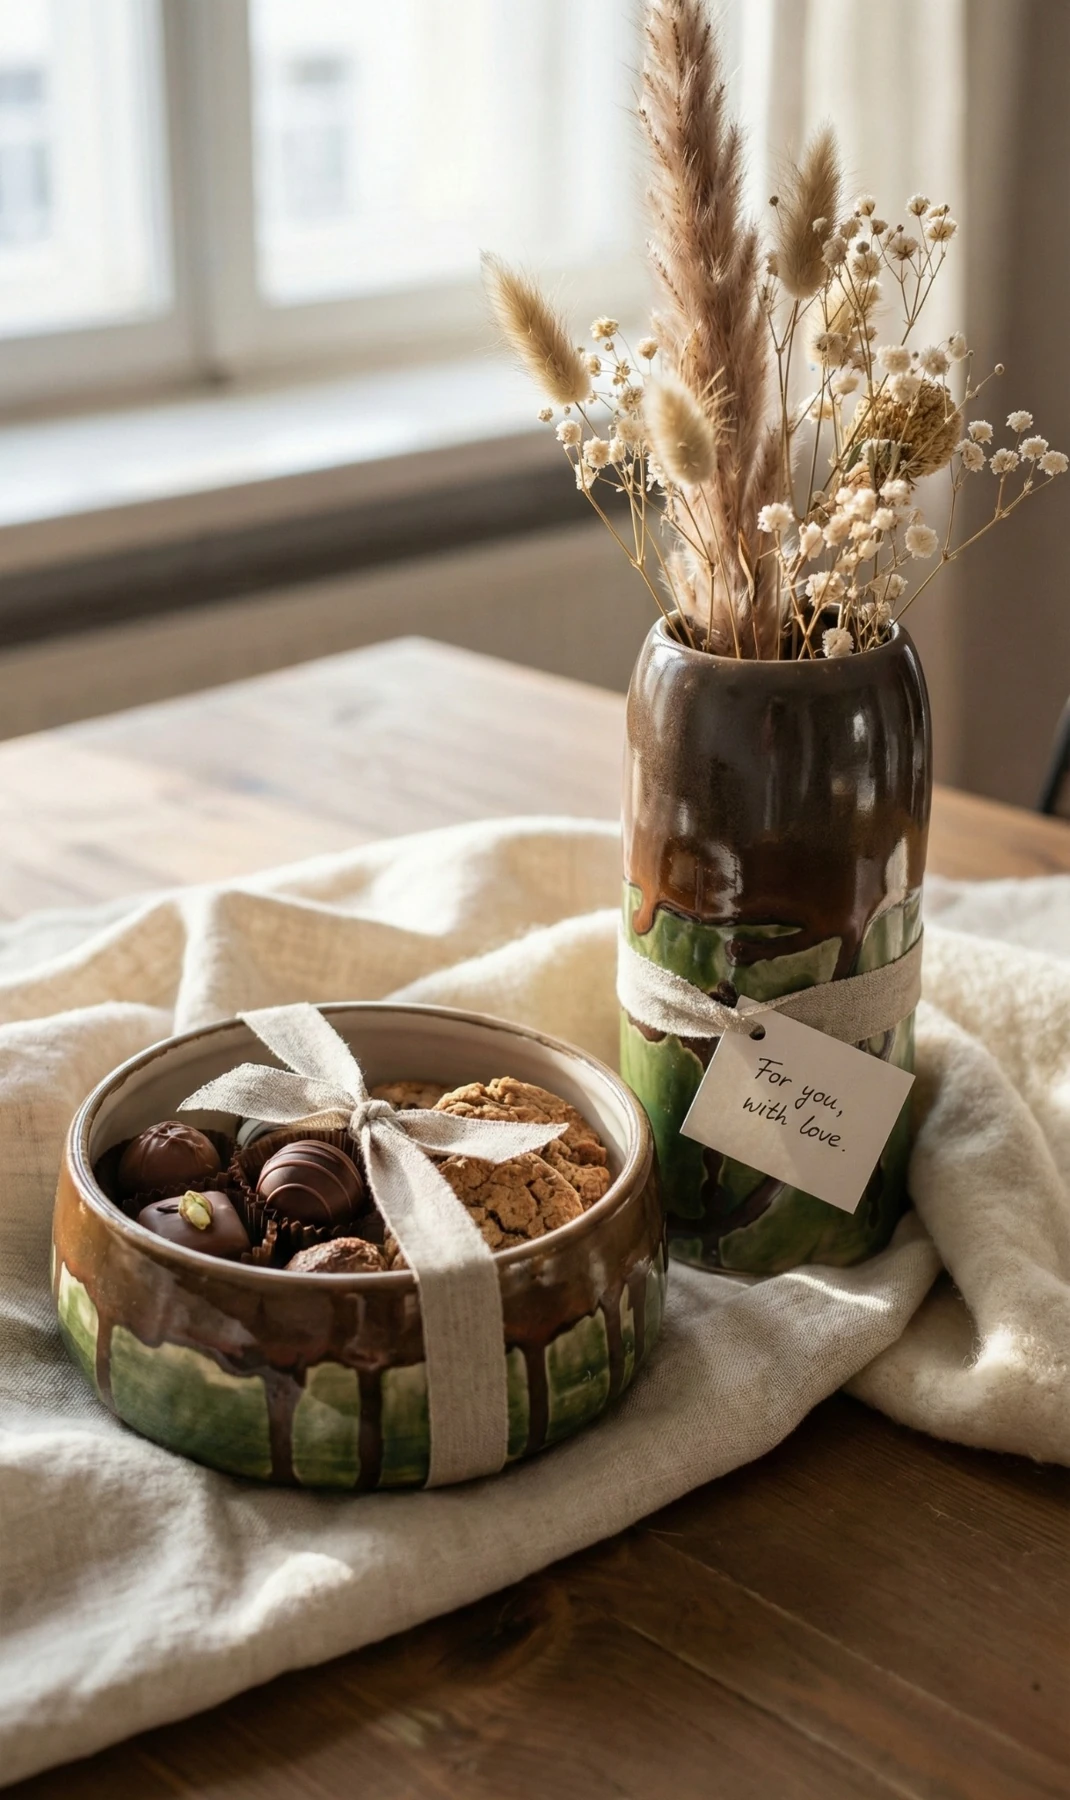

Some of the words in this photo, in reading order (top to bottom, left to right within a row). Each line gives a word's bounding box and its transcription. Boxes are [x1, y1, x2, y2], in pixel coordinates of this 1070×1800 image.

[754, 1057, 793, 1087] For
[794, 1085, 844, 1118] you,
[742, 1096, 788, 1126] with
[799, 1115, 846, 1152] love.
